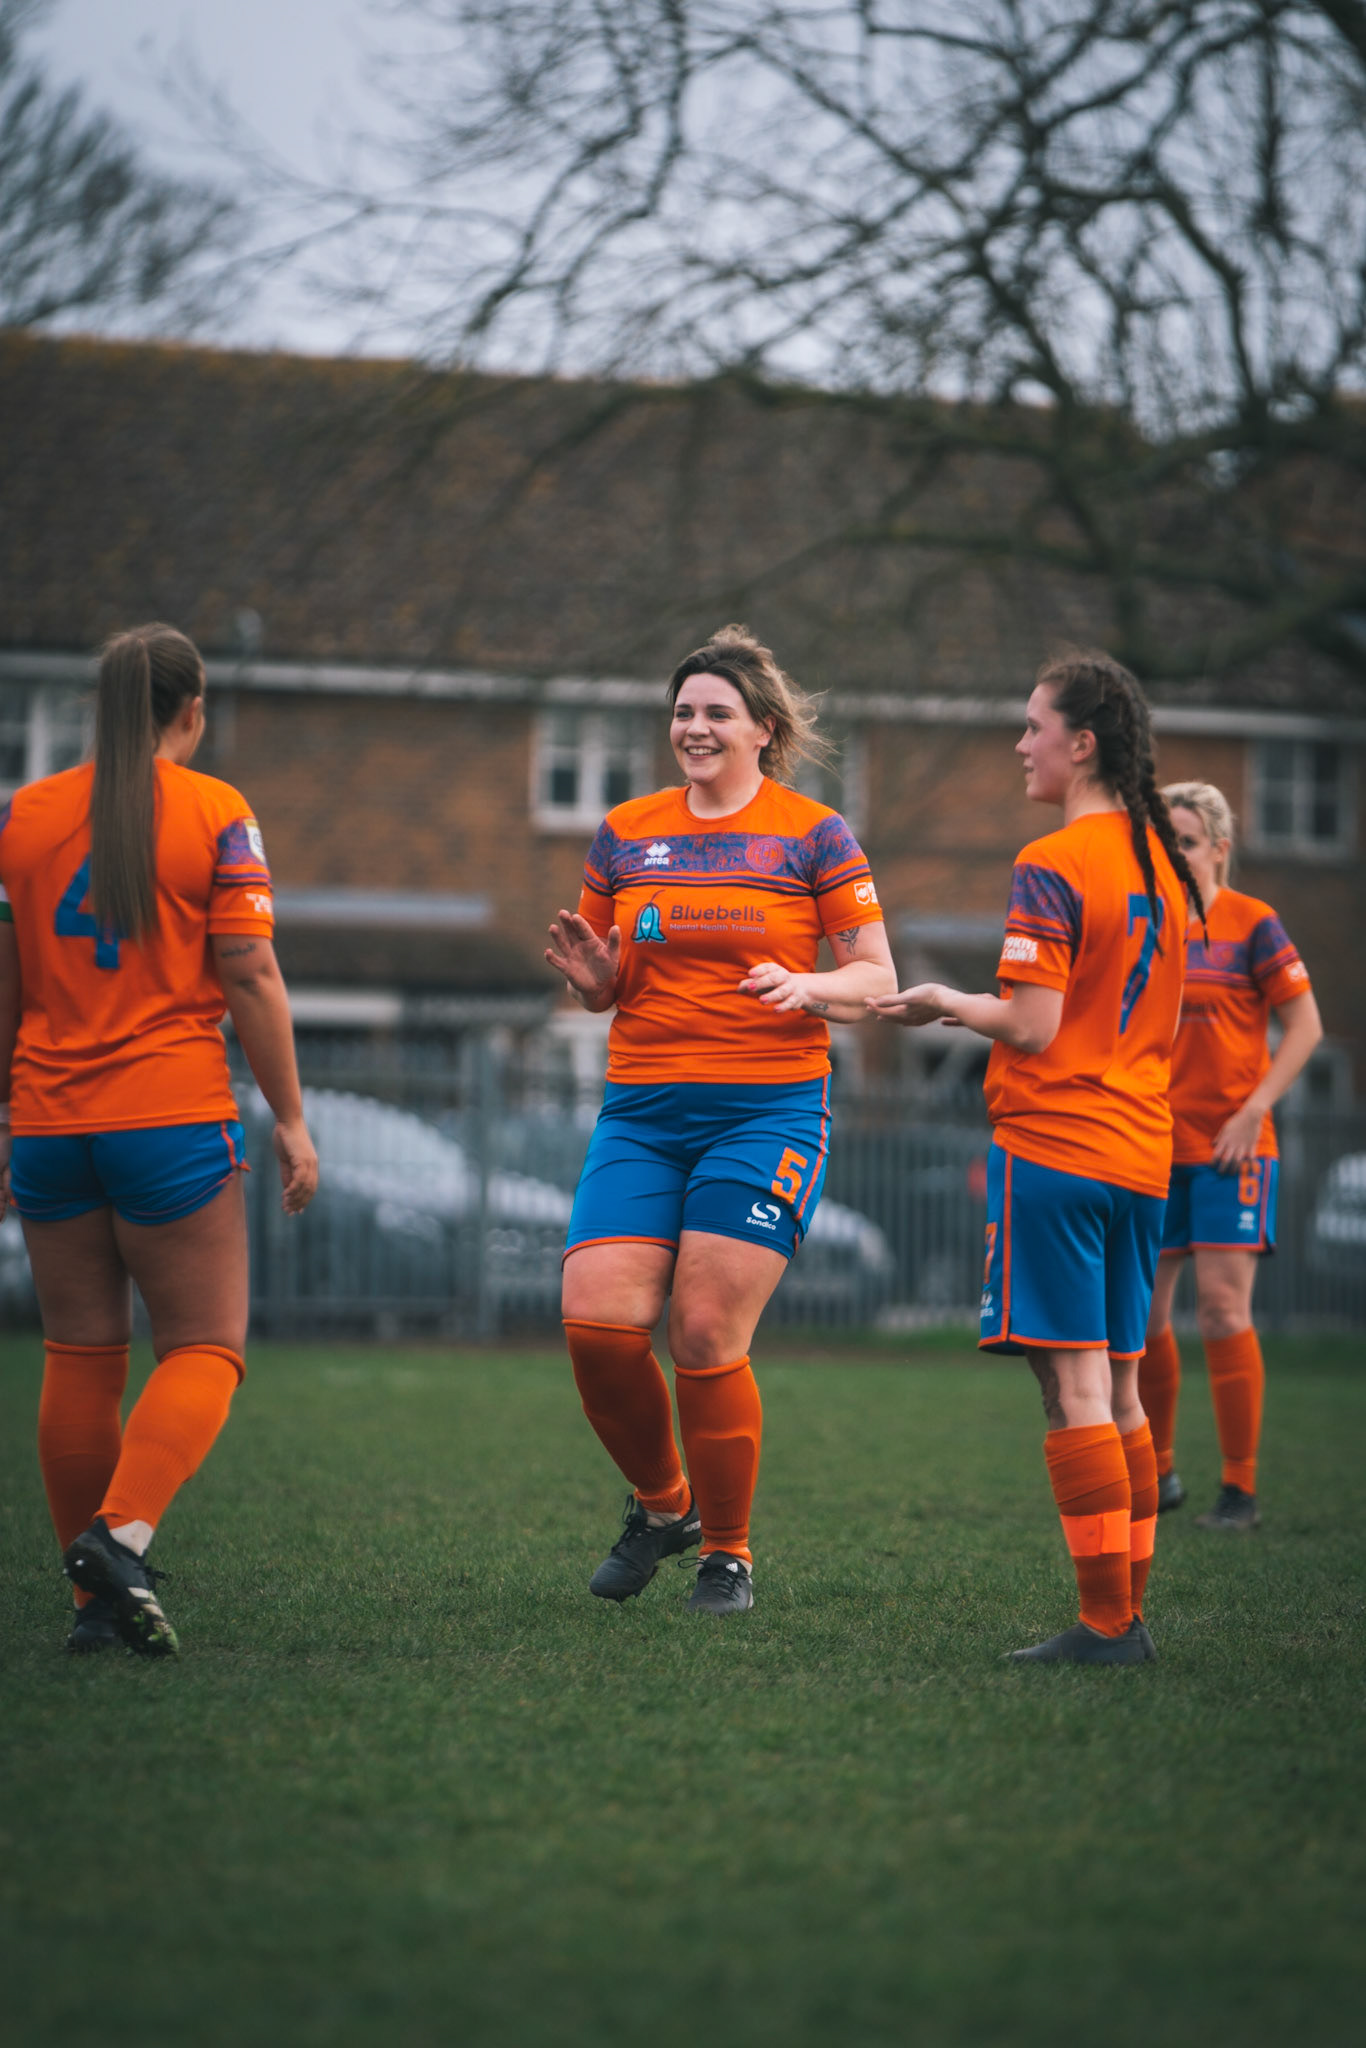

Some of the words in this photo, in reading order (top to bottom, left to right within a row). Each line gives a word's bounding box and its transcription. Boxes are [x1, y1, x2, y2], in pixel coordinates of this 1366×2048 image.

[670, 923, 698, 931] Mental
[731, 924, 766, 934] Training
[671, 905, 765, 922] Bluebells
[1119, 893, 1164, 1034] 7
[771, 1147, 808, 1204] 5
[1238, 1159, 1262, 1206] 6
[746, 1217, 776, 1230] Sondico
